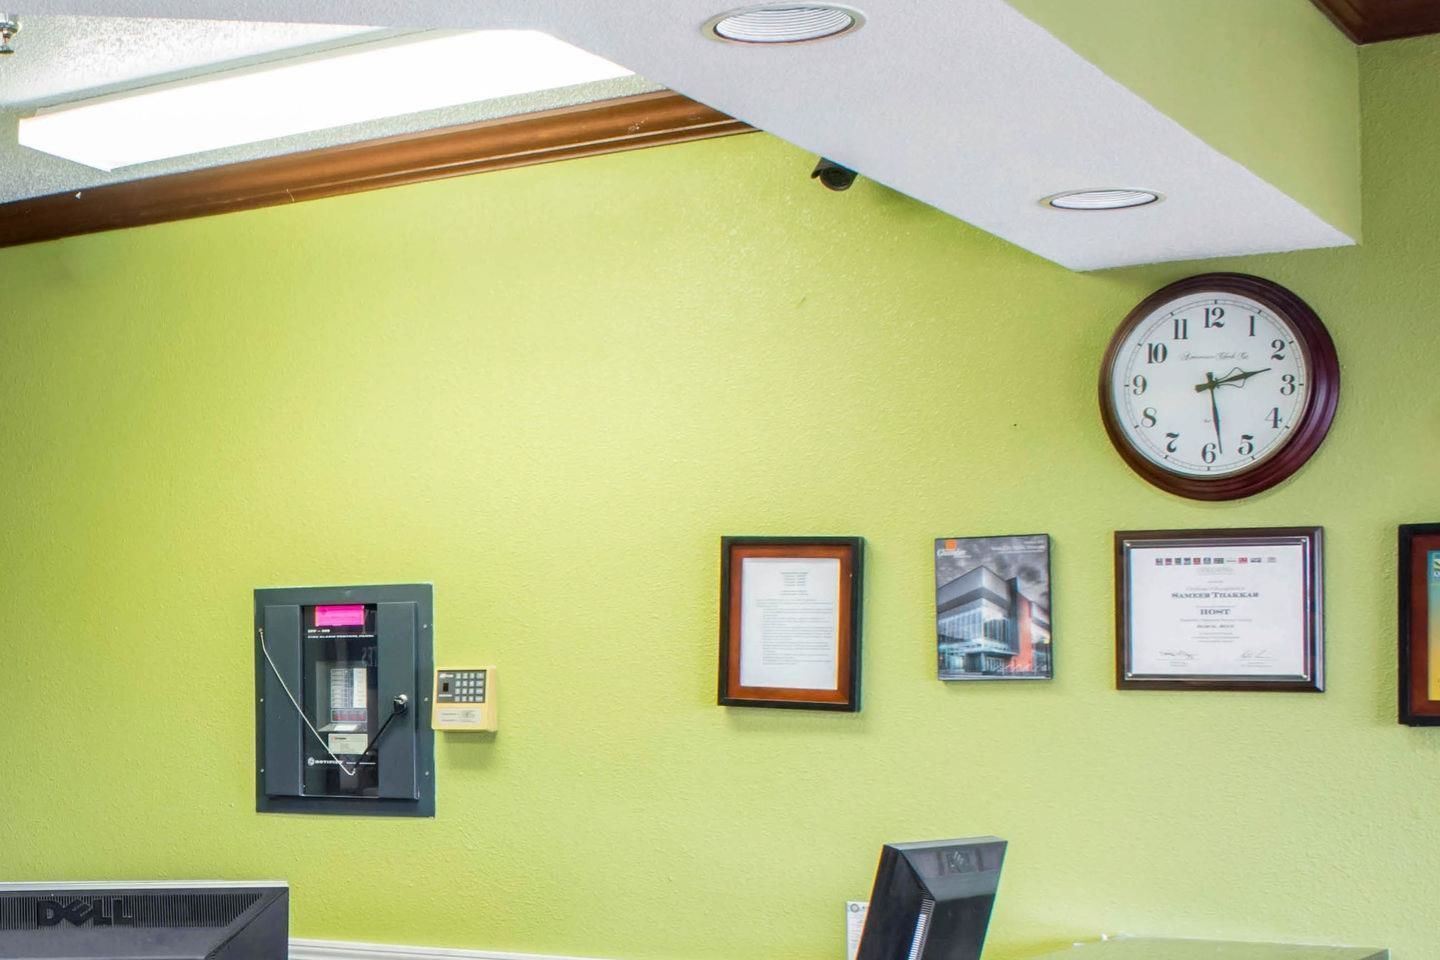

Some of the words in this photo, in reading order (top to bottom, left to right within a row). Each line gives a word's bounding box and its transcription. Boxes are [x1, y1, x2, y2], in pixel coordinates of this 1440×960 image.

[1173, 318, 1189, 340] 11
[1203, 307, 1225, 329] 12
[1248, 315, 1256, 337] 1
[1147, 342, 1168, 364] 10
[1270, 339, 1286, 361] 2
[1132, 374, 1147, 396] 9
[1279, 374, 1296, 396] 3
[1141, 407, 1157, 428] 8
[1265, 407, 1283, 429] 4
[1165, 432, 1180, 453] 7
[1201, 443, 1217, 464] 6
[1237, 434, 1254, 456] 5
[37, 899, 134, 926] DELL
